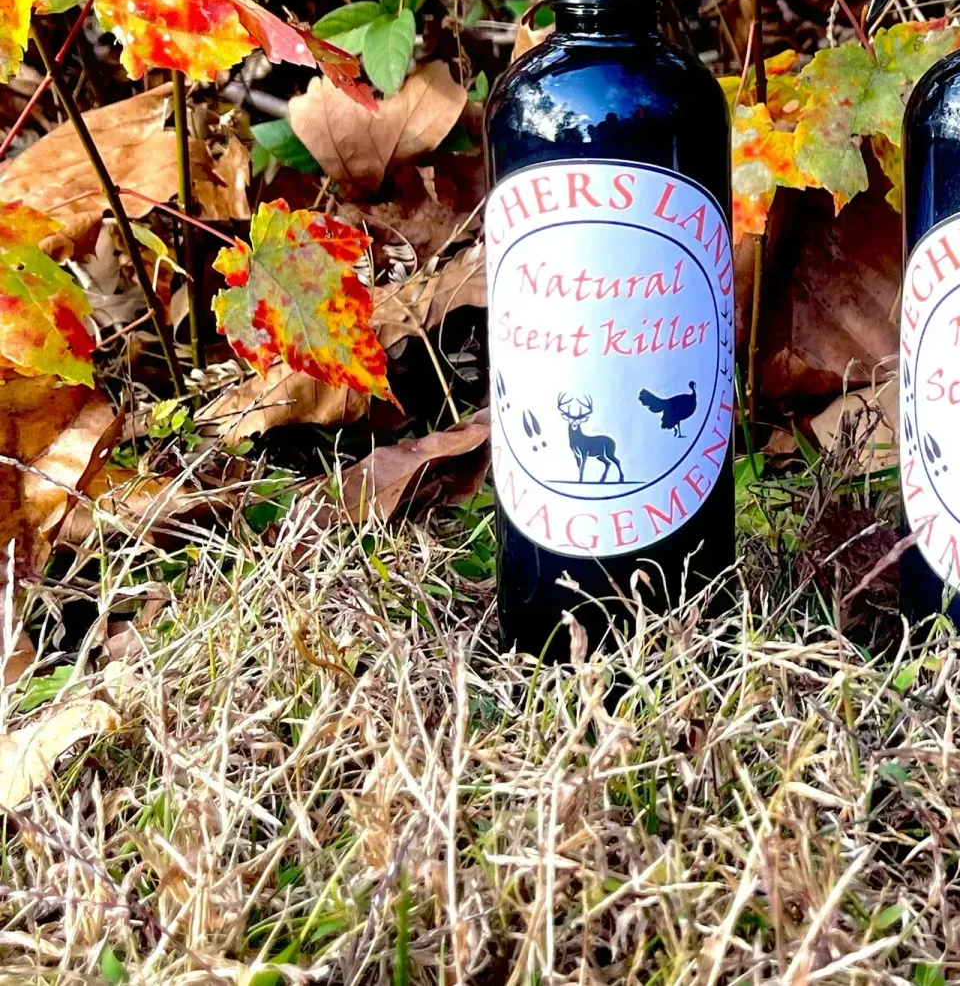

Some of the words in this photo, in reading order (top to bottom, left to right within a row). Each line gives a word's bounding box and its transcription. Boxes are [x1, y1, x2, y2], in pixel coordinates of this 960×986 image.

[488, 171, 638, 250] CHERS
[653, 181, 734, 297] LAND
[516, 258, 685, 300] Natural
[496, 310, 591, 358] Scent
[599, 314, 713, 357] killer
[491, 390, 734, 550] ANAGEMENT
